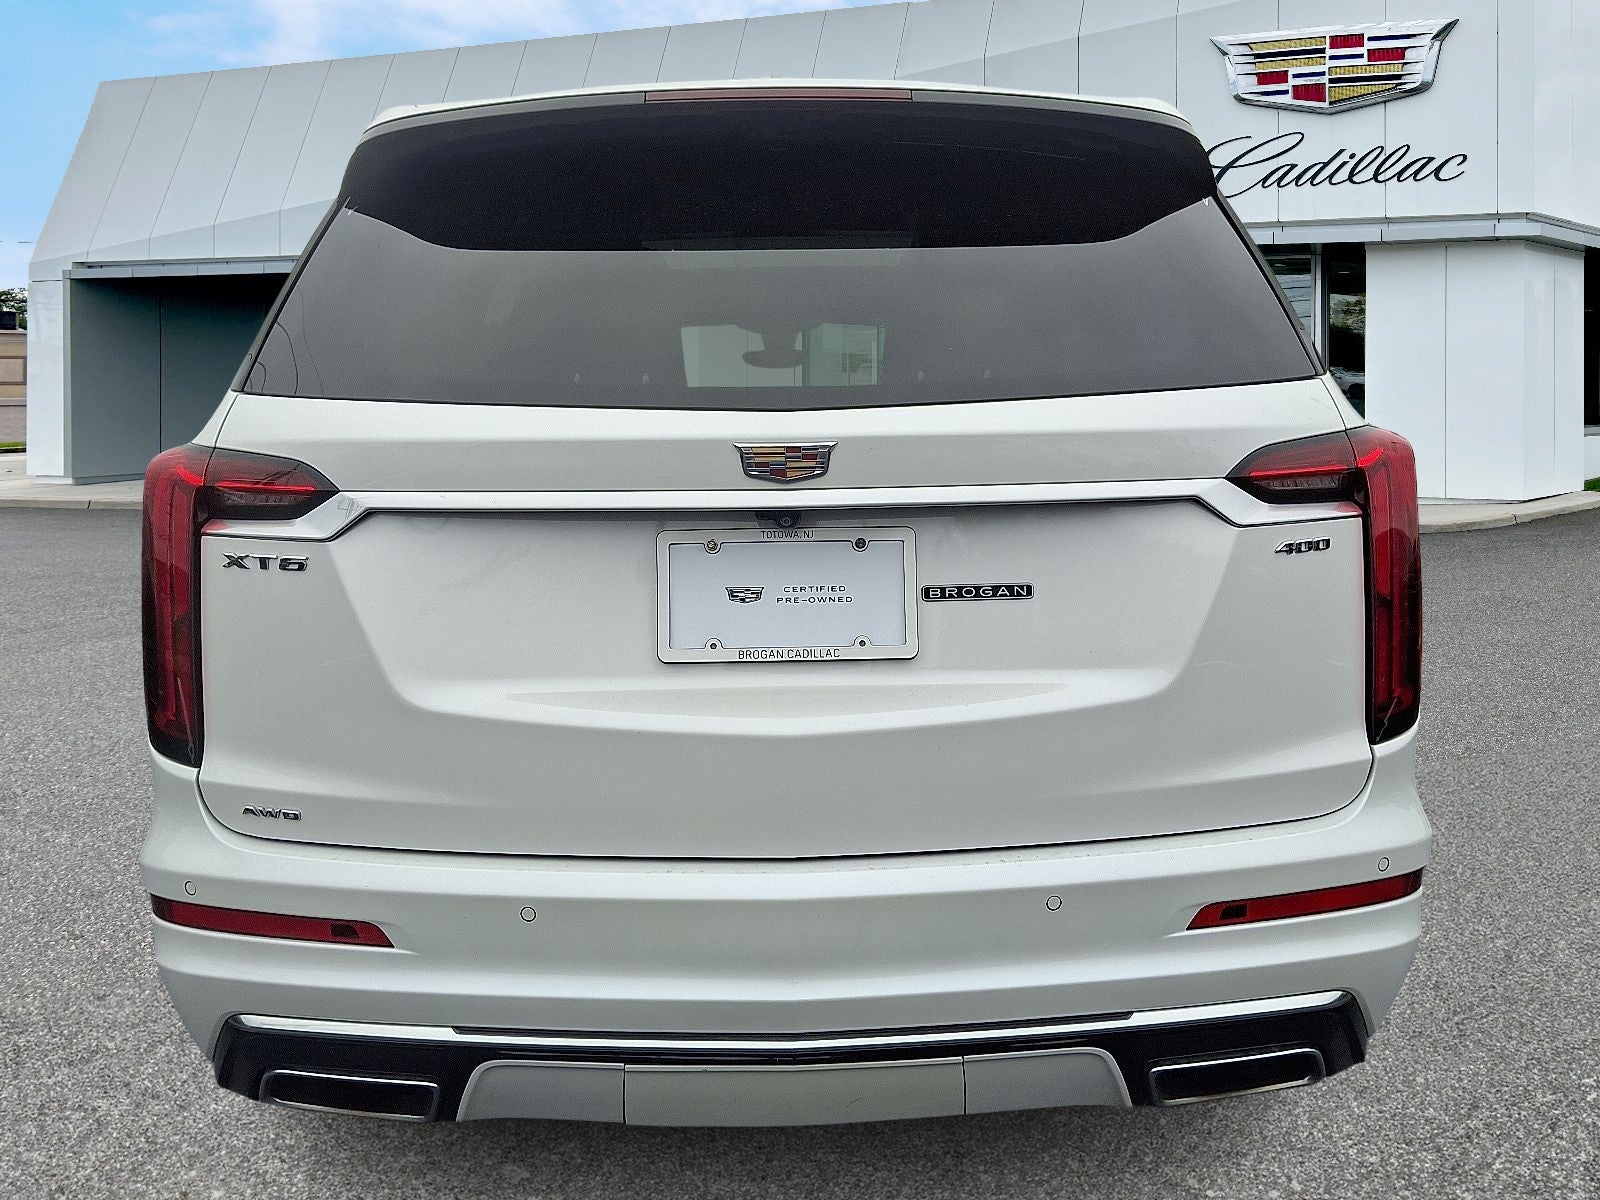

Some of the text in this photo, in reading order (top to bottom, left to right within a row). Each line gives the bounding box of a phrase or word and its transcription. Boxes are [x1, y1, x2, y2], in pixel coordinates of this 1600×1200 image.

[1206, 131, 1468, 198] Cadillac
[803, 530, 815, 539] NJ
[1274, 536, 1332, 555] 400
[222, 552, 309, 571] XT6
[783, 585, 846, 593] CERTIFIED
[929, 585, 1027, 598] BROGAN
[776, 596, 853, 604] PRE-OWNED
[738, 648, 841, 660] BROGAN CADILLAC
[242, 805, 302, 821] AWD
